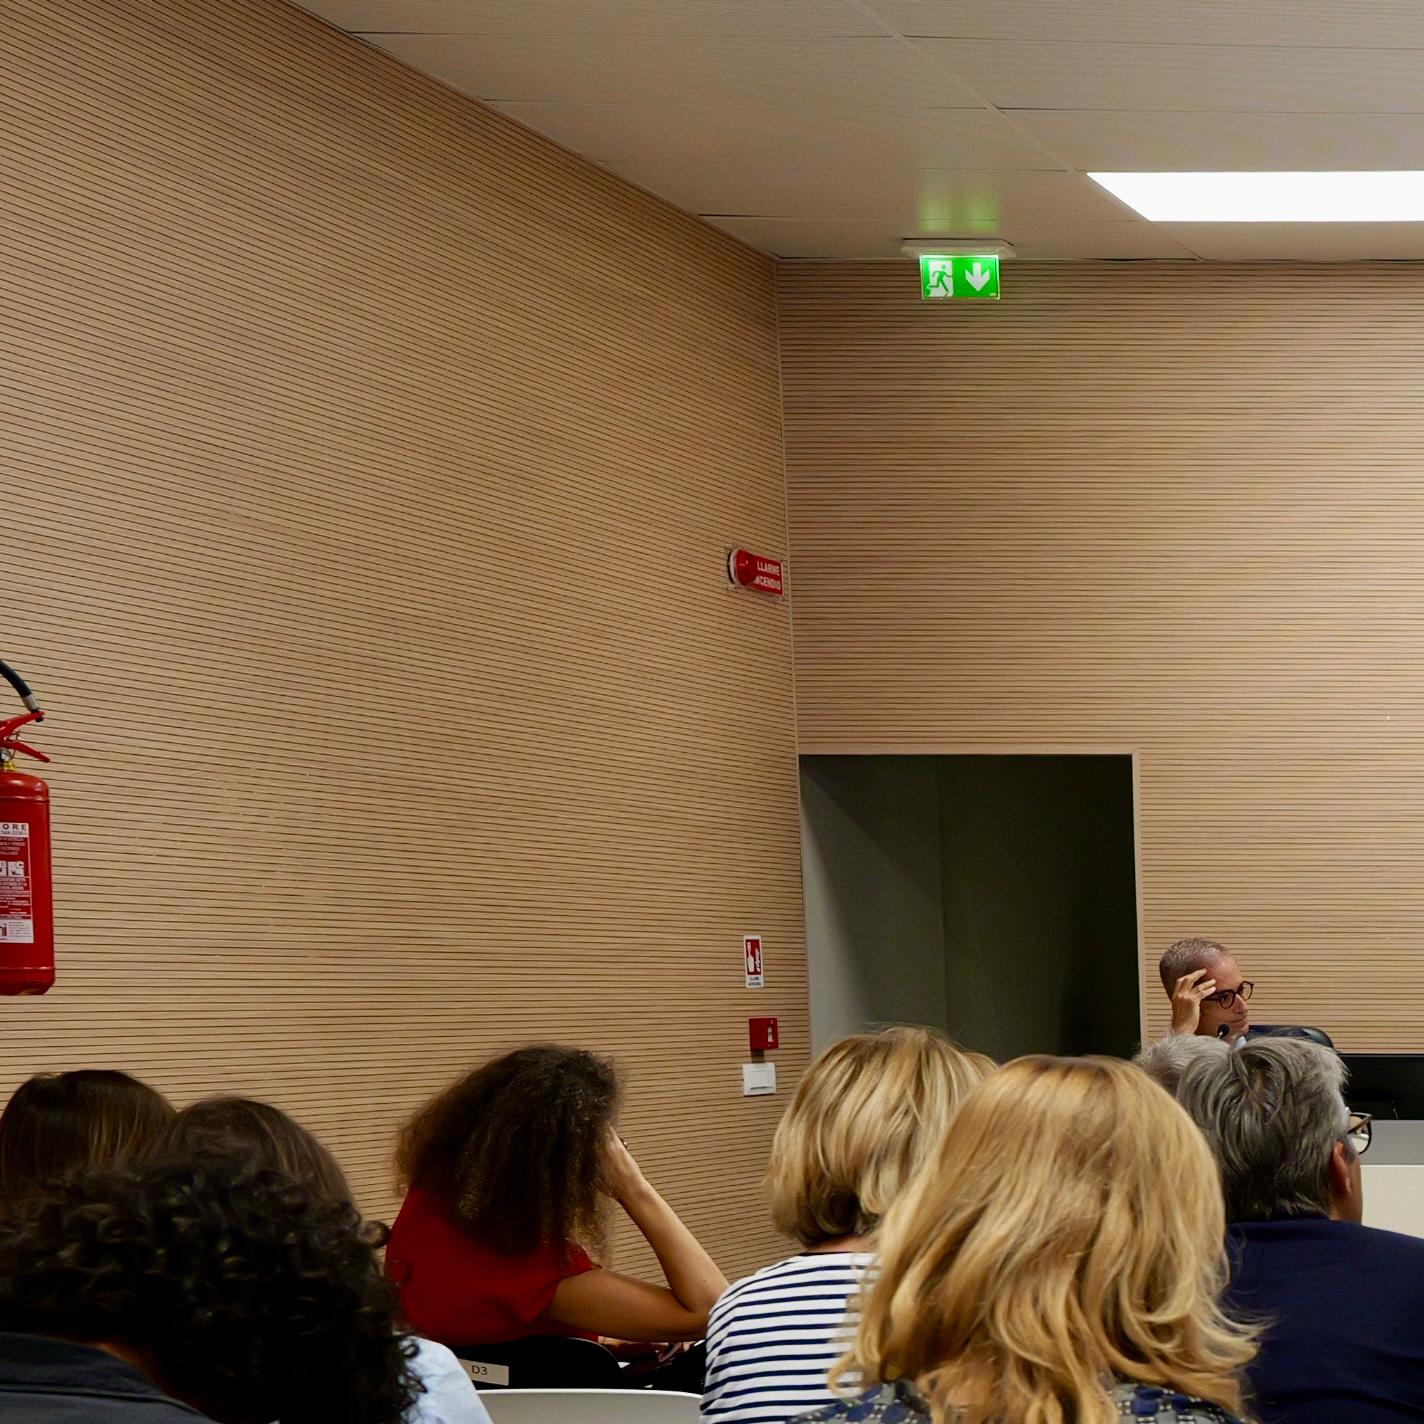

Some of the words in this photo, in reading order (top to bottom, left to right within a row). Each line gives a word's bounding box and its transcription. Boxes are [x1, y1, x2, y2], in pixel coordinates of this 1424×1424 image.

[756, 560, 780, 577] LLARME
[753, 574, 781, 591] NCENDIO
[471, 1365, 488, 1376] D3
